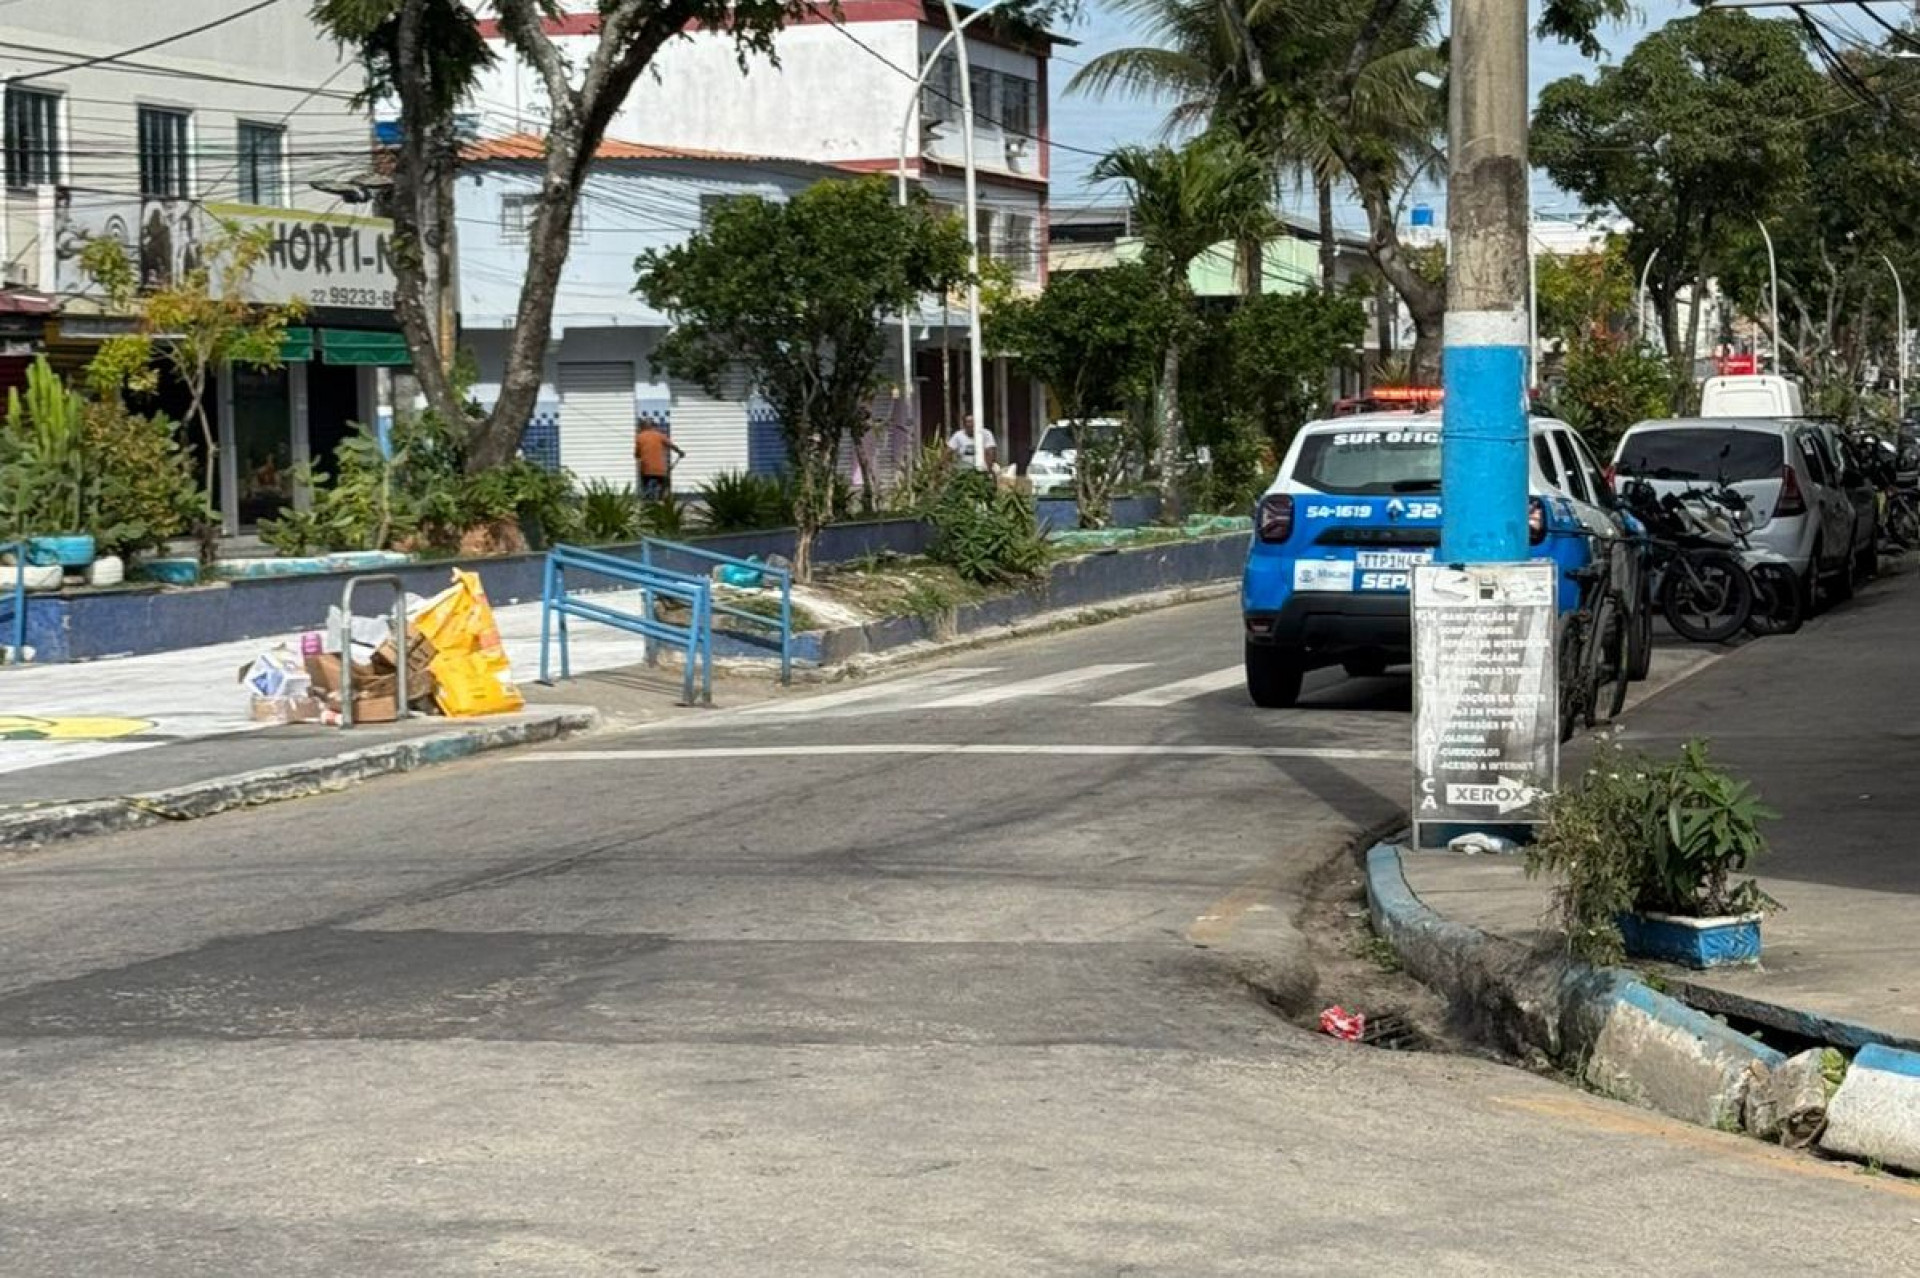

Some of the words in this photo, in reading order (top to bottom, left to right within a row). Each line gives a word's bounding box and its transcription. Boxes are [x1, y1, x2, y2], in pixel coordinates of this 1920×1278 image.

[310, 290, 325, 303] 22
[329, 286, 394, 306] 99233-8
[1333, 432, 1380, 446] SUP.
[1385, 431, 1442, 443] OFIC
[1306, 504, 1372, 518] 54-1619
[1405, 502, 1442, 519] 32
[1361, 573, 1411, 589] SEP
[1455, 787, 1524, 802] XEROX
